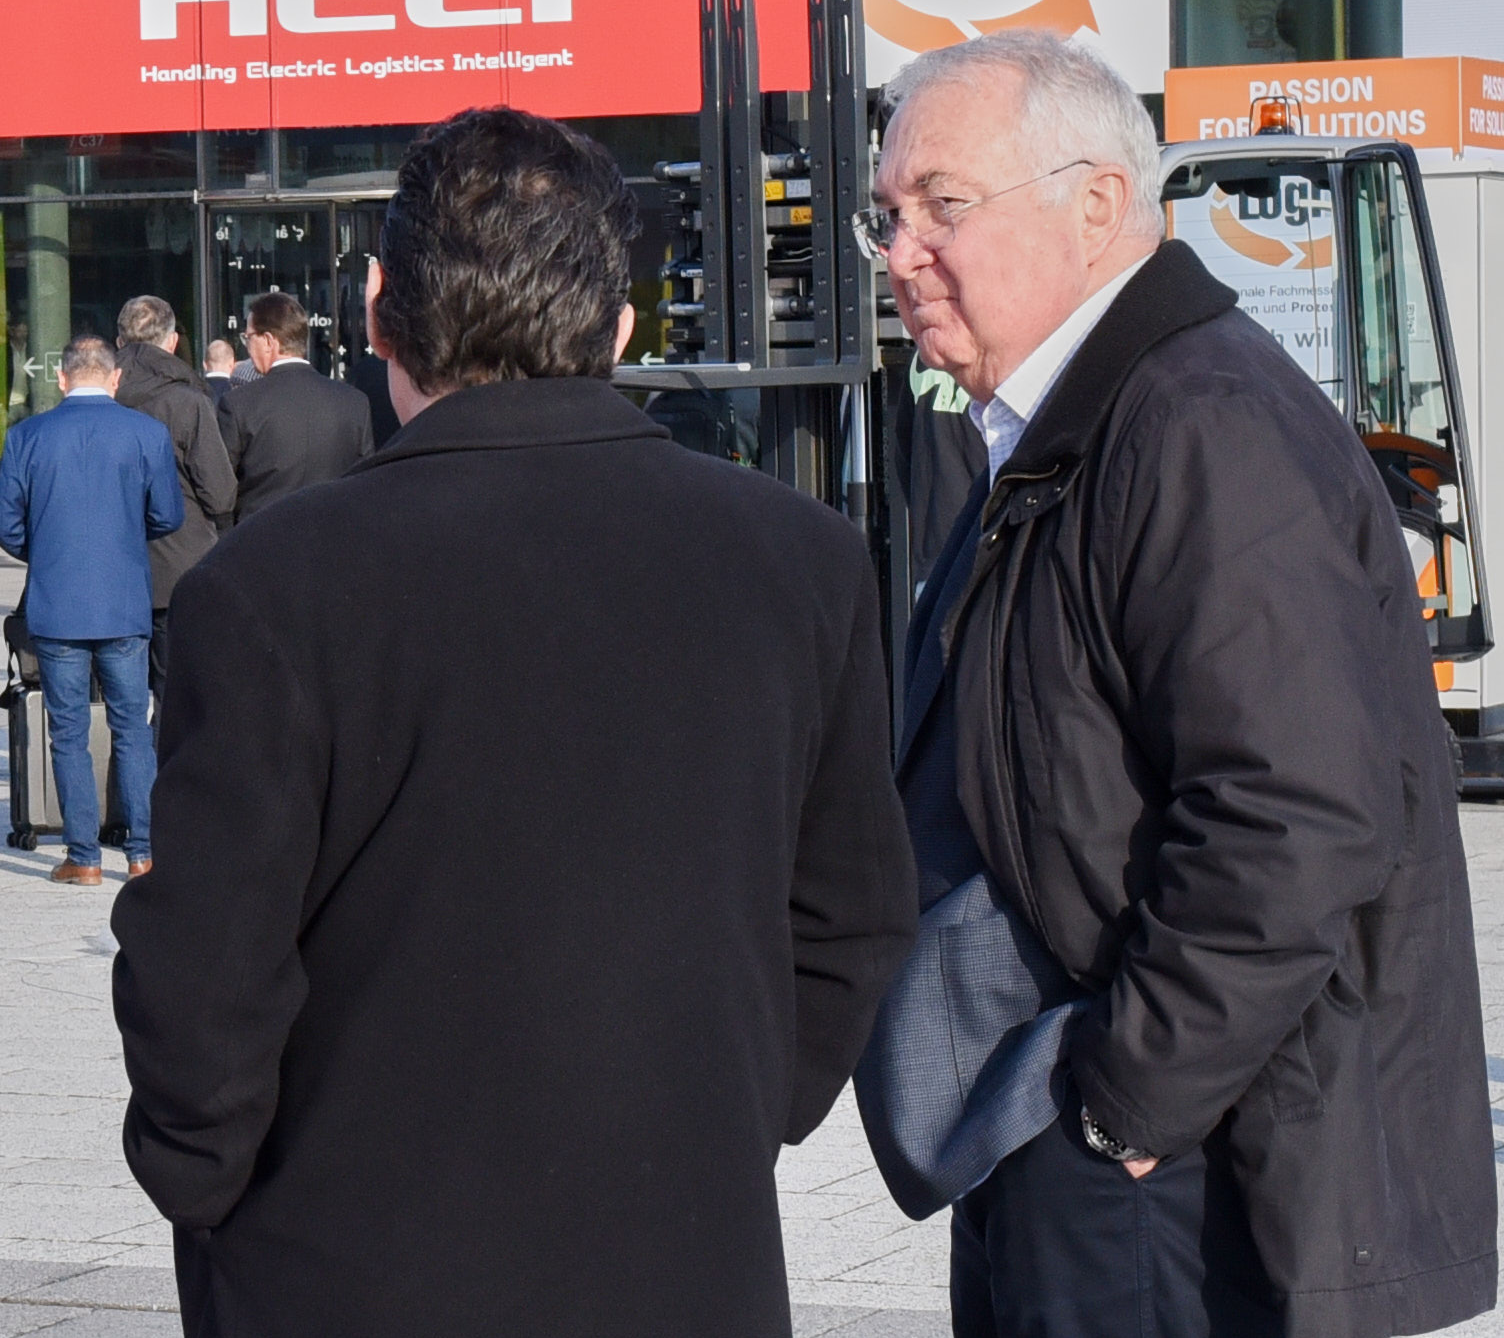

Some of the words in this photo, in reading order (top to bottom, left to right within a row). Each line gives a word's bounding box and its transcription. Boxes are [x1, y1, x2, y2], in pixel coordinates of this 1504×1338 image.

[140, 61, 237, 85] Handling
[245, 56, 337, 79] Electric
[344, 52, 445, 78] Logistics
[452, 47, 573, 74] Intelligent
[1249, 76, 1373, 104] PASSION
[1469, 110, 1485, 134] FOR
[1264, 302, 1286, 314] und
